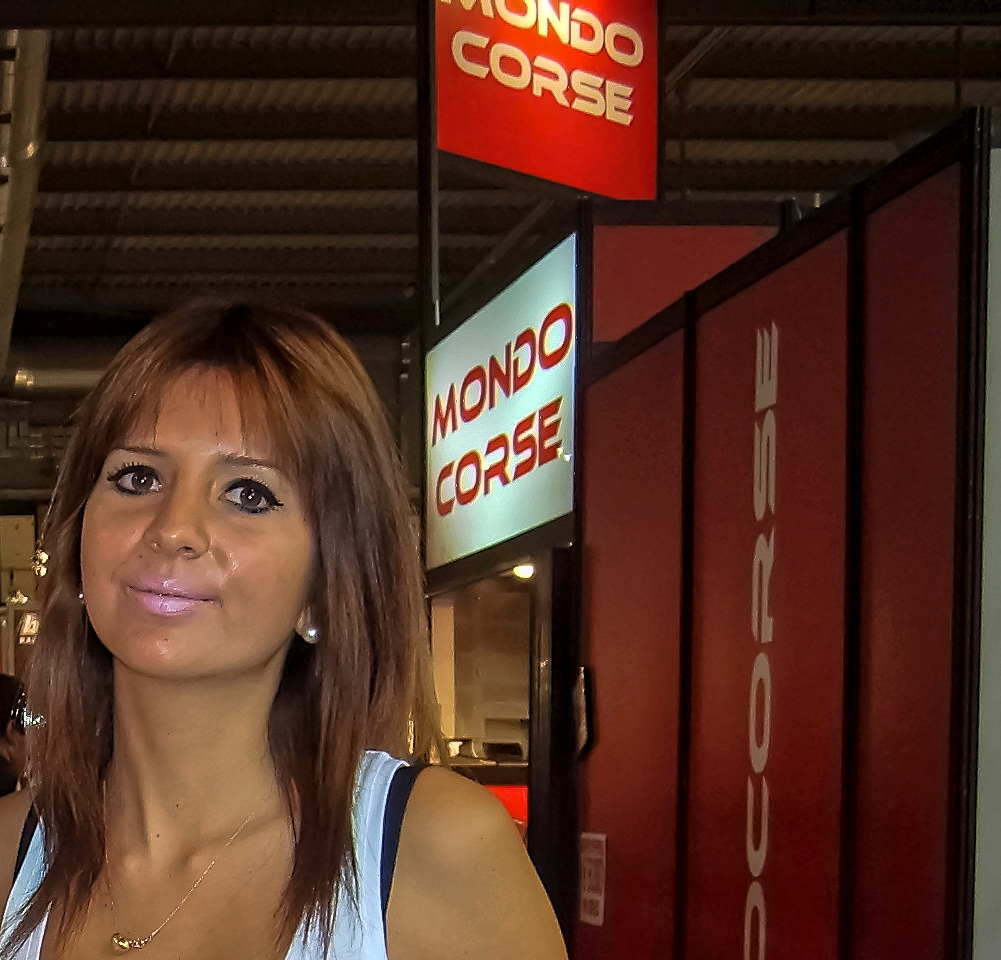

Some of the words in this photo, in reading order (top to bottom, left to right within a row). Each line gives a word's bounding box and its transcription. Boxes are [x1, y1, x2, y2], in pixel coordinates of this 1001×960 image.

[451, 30, 635, 126] CORSE
[431, 302, 574, 447] MONDO
[435, 395, 564, 516] CORSE
